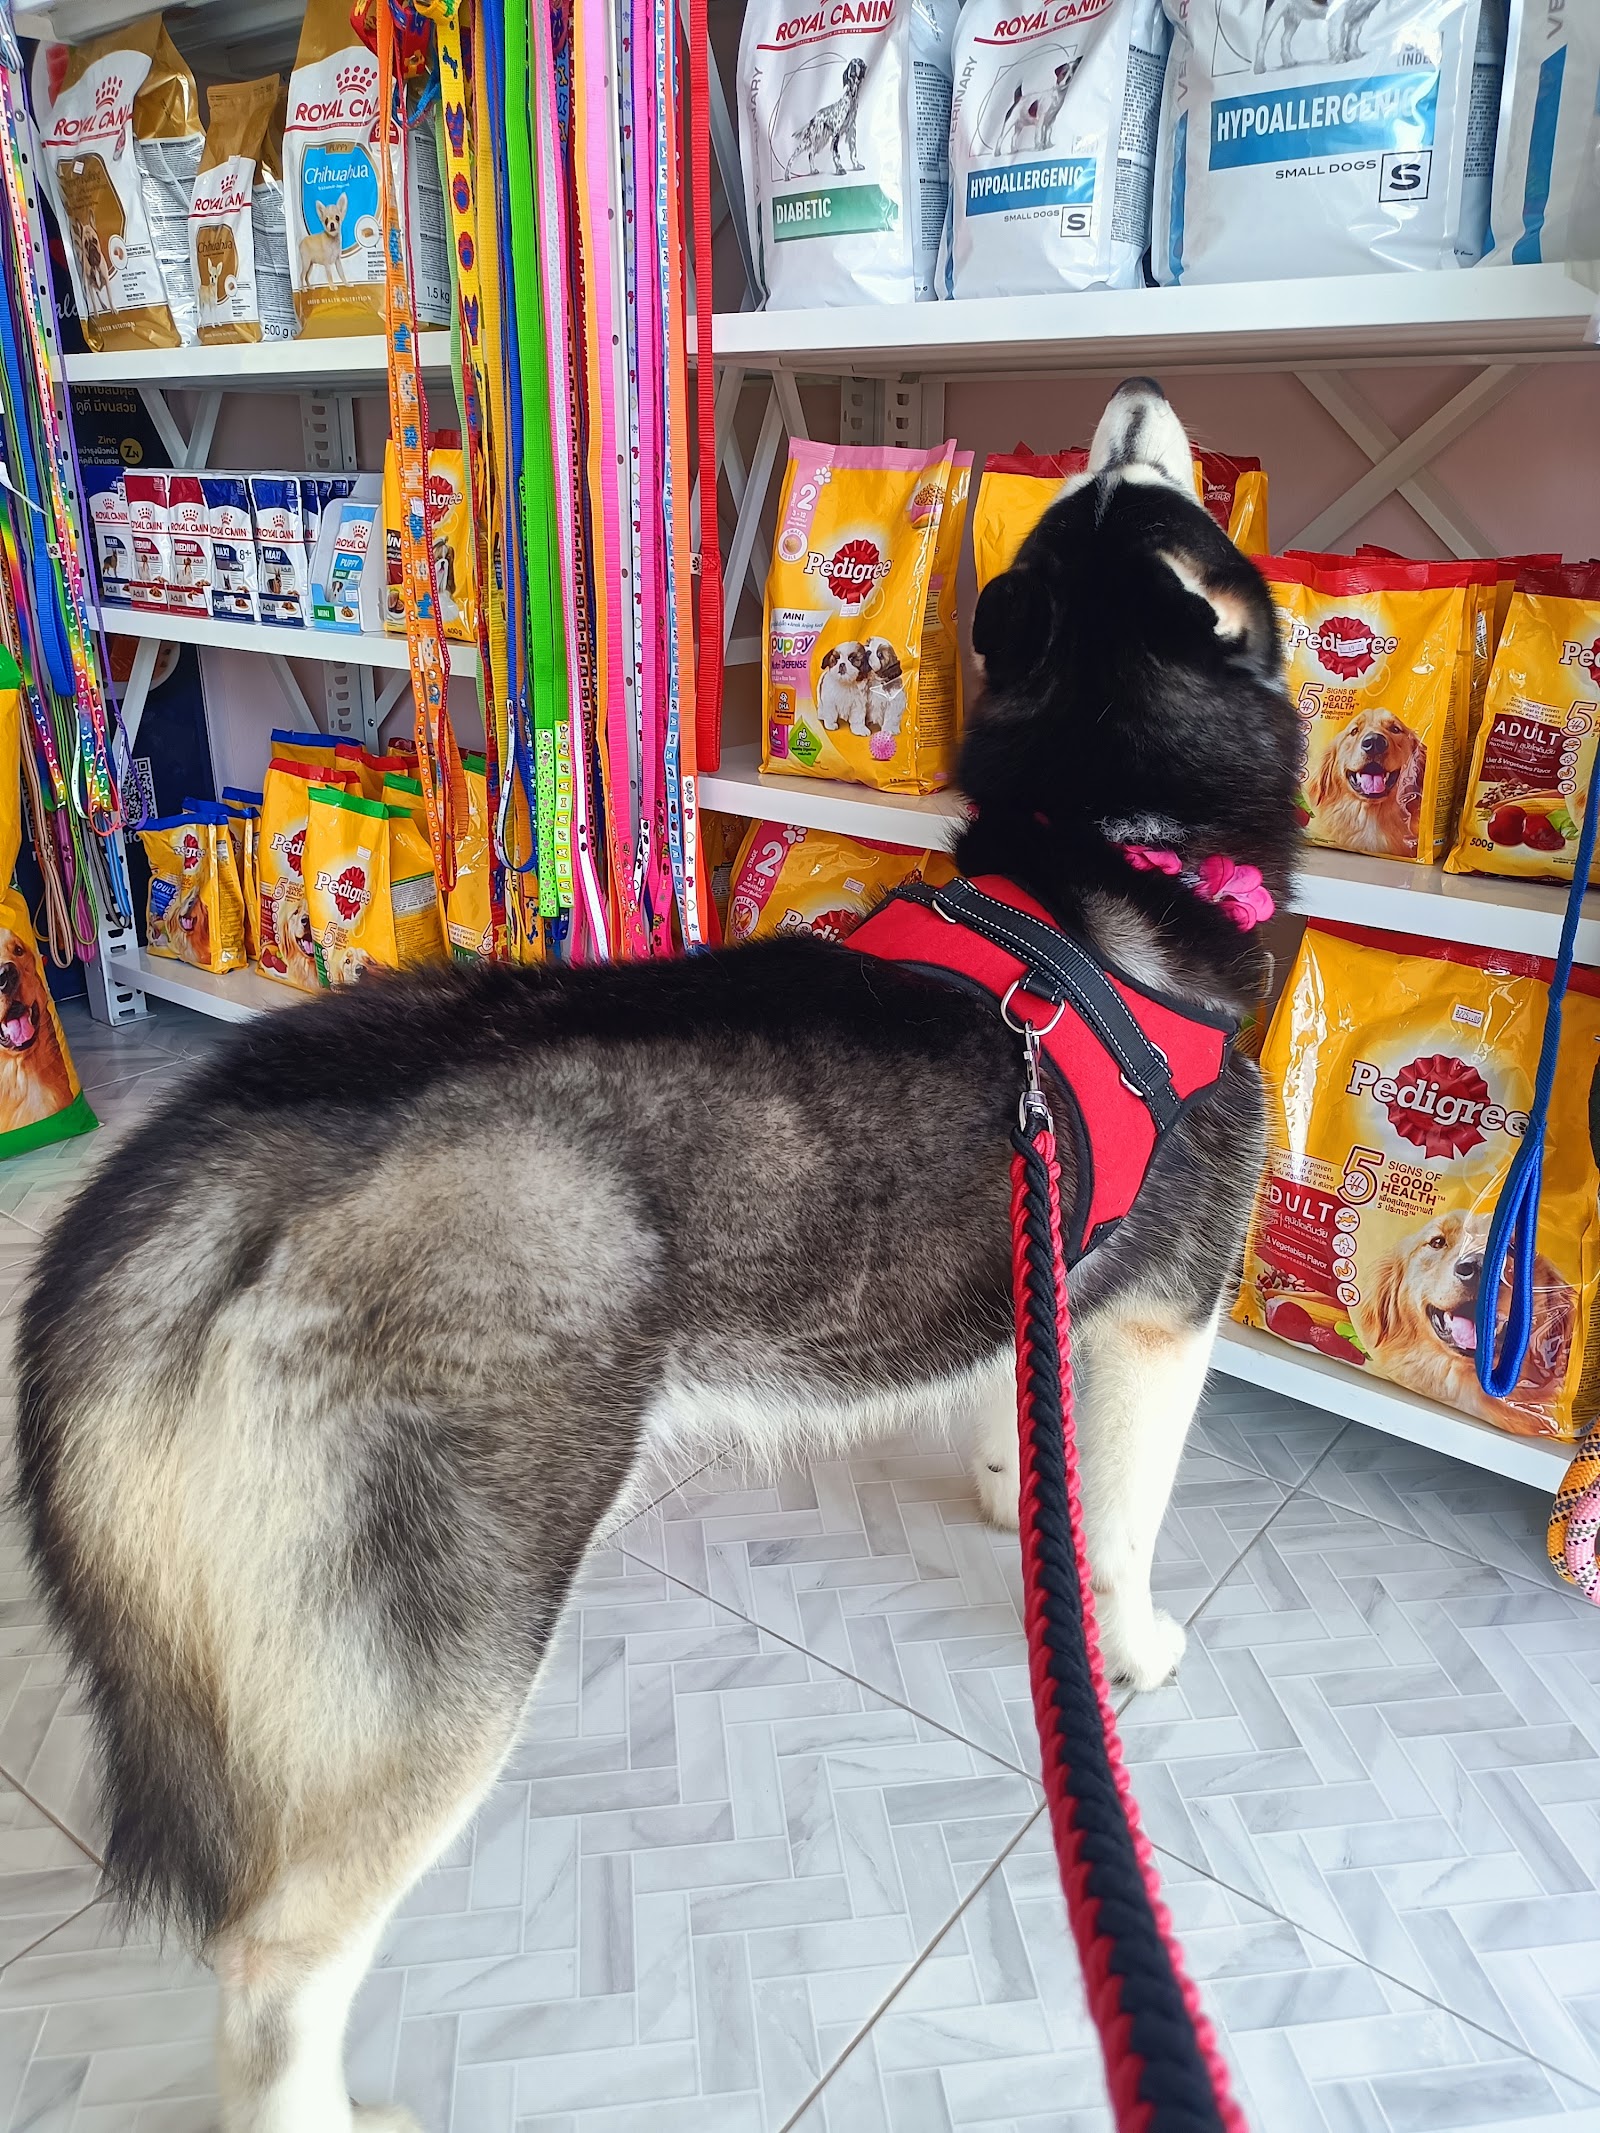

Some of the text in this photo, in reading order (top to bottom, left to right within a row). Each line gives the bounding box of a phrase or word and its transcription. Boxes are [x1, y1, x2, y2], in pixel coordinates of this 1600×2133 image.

[775, 0, 893, 41] ROYAL CANIN
[994, 10, 1048, 37] ROYAL
[1054, 0, 1105, 23] CANIN
[295, 99, 344, 122] ROYAL
[54, 115, 98, 137] ROYAL
[304, 164, 369, 185] Chihuahua
[1275, 159, 1377, 180] SMALL DOGS
[1390, 163, 1421, 191] S
[970, 165, 1084, 199] HYPOALLERGENIC
[194, 196, 223, 211] ROYAL
[775, 197, 832, 224] DIABETIC
[1004, 209, 1060, 222] SMALL DOGS
[1067, 213, 1085, 230] S
[427, 286, 450, 304] 1.5 kg
[264, 324, 280, 336] 500
[282, 326, 289, 338] g
[97, 435, 117, 444] Zinc
[797, 484, 817, 511] 2
[95, 512, 110, 520] ROYAL
[171, 522, 189, 532] ROYAL
[225, 528, 247, 537] CANIN
[175, 543, 198, 553] MEDIUM
[336, 538, 356, 549] ROYAL
[215, 548, 230, 557] MAXI
[264, 551, 281, 561] MAXI
[340, 558, 360, 568] PUPPY
[803, 552, 892, 583] Pedigree
[317, 609, 330, 617] MINI
[782, 612, 805, 621] MINI
[770, 635, 815, 658] puppy
[781, 659, 807, 670] DEFENSE
[1326, 687, 1347, 695] SIGNS
[1296, 682, 1325, 719] 5
[1560, 700, 1598, 737] 5
[1490, 736, 1515, 747] complete
[1494, 720, 1560, 746] ADULT
[1489, 741, 1513, 751] nutrition
[1502, 759, 1533, 773] Vegetables
[1533, 766, 1552, 774] Flavor
[1470, 837, 1494, 852] 500g
[747, 849, 759, 869] STAGE
[755, 841, 783, 878] 2
[152, 877, 176, 894] ADULT
[314, 871, 371, 905] Pedigree
[746, 873, 753, 881] 3
[757, 877, 766, 887] 18
[736, 897, 757, 909] MILKY
[1346, 1060, 1530, 1137] Pedigree
[1309, 1161, 1332, 1173] proven
[1337, 1146, 1385, 1205] 5
[1388, 1161, 1443, 1182] SIGNS OF
[1313, 1172, 1334, 1182] weeks
[1271, 1237, 1307, 1260] Vegetables
[1306, 1254, 1328, 1269] Flavor
